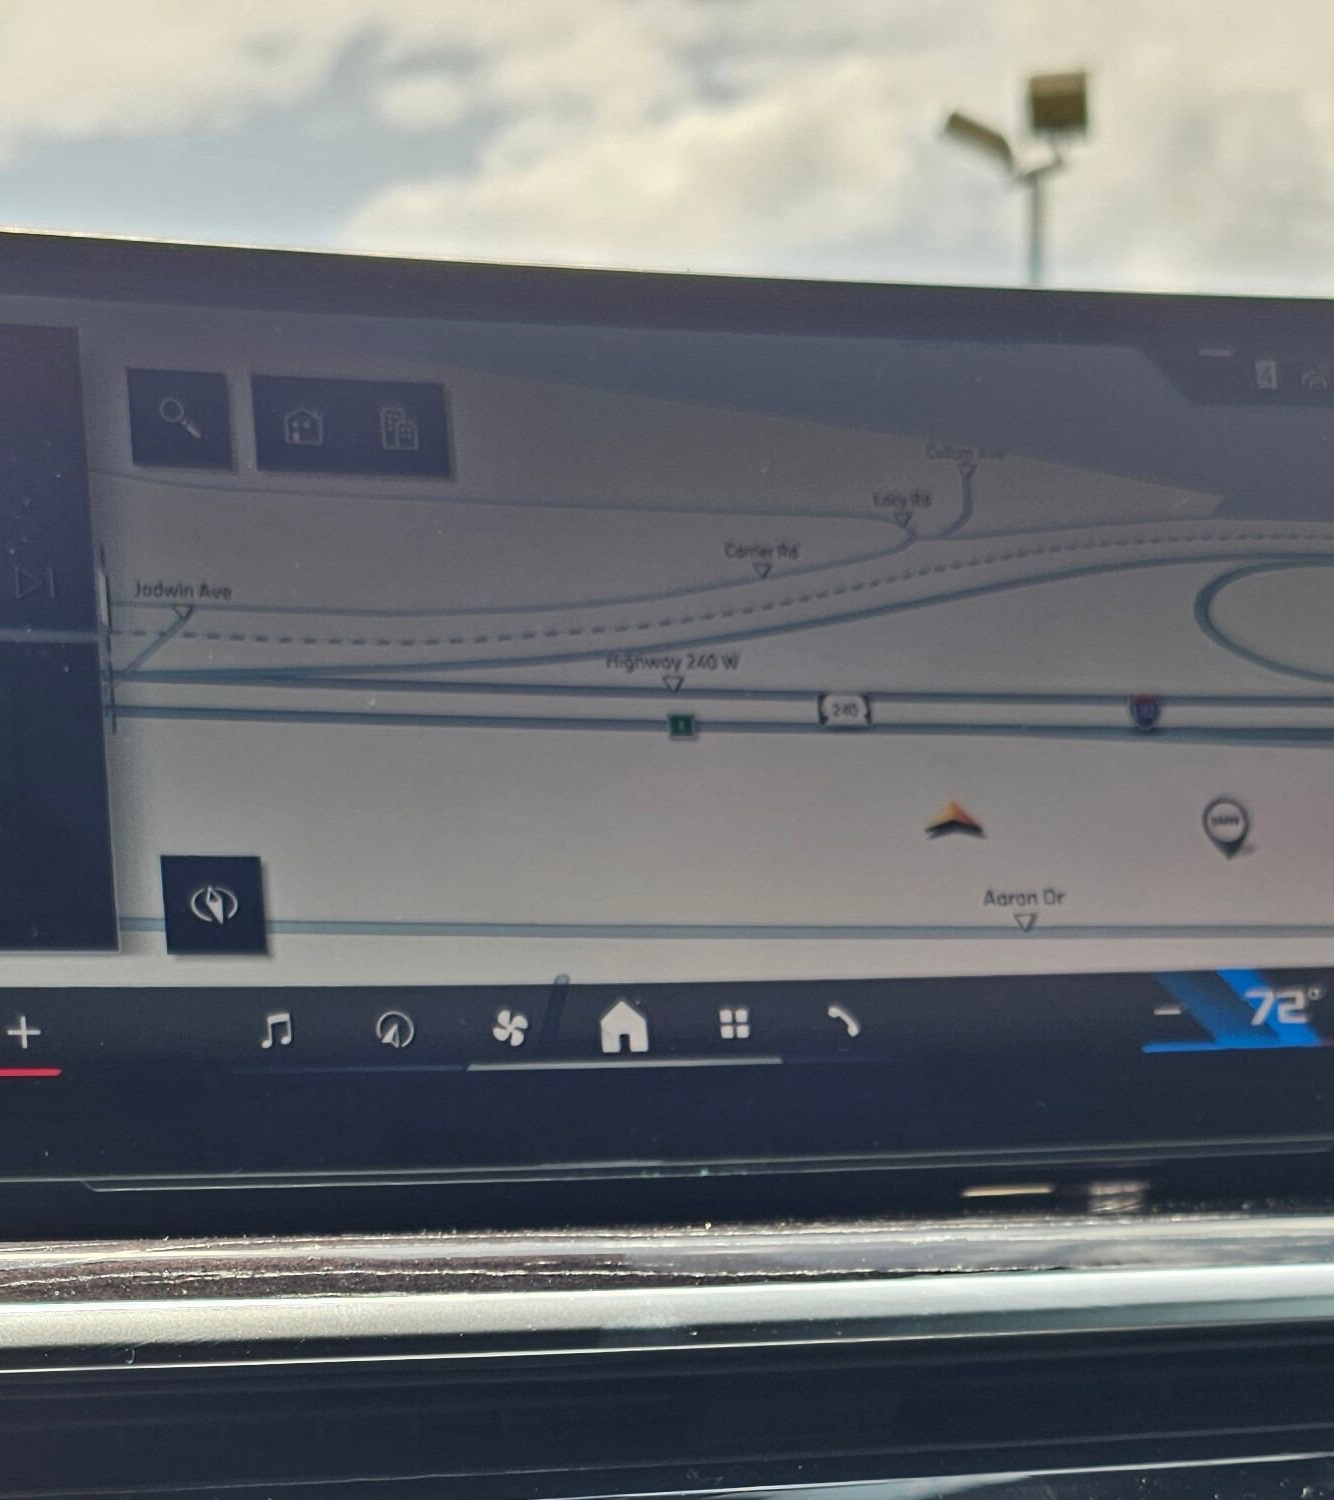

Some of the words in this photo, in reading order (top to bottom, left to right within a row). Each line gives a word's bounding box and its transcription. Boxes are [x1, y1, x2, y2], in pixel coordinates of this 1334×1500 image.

[199, 582, 233, 600] Ave
[606, 655, 681, 673] Highway
[686, 655, 717, 671] 240
[721, 655, 740, 670] W
[983, 888, 1038, 906] Aaron
[1042, 888, 1066, 906] Dr
